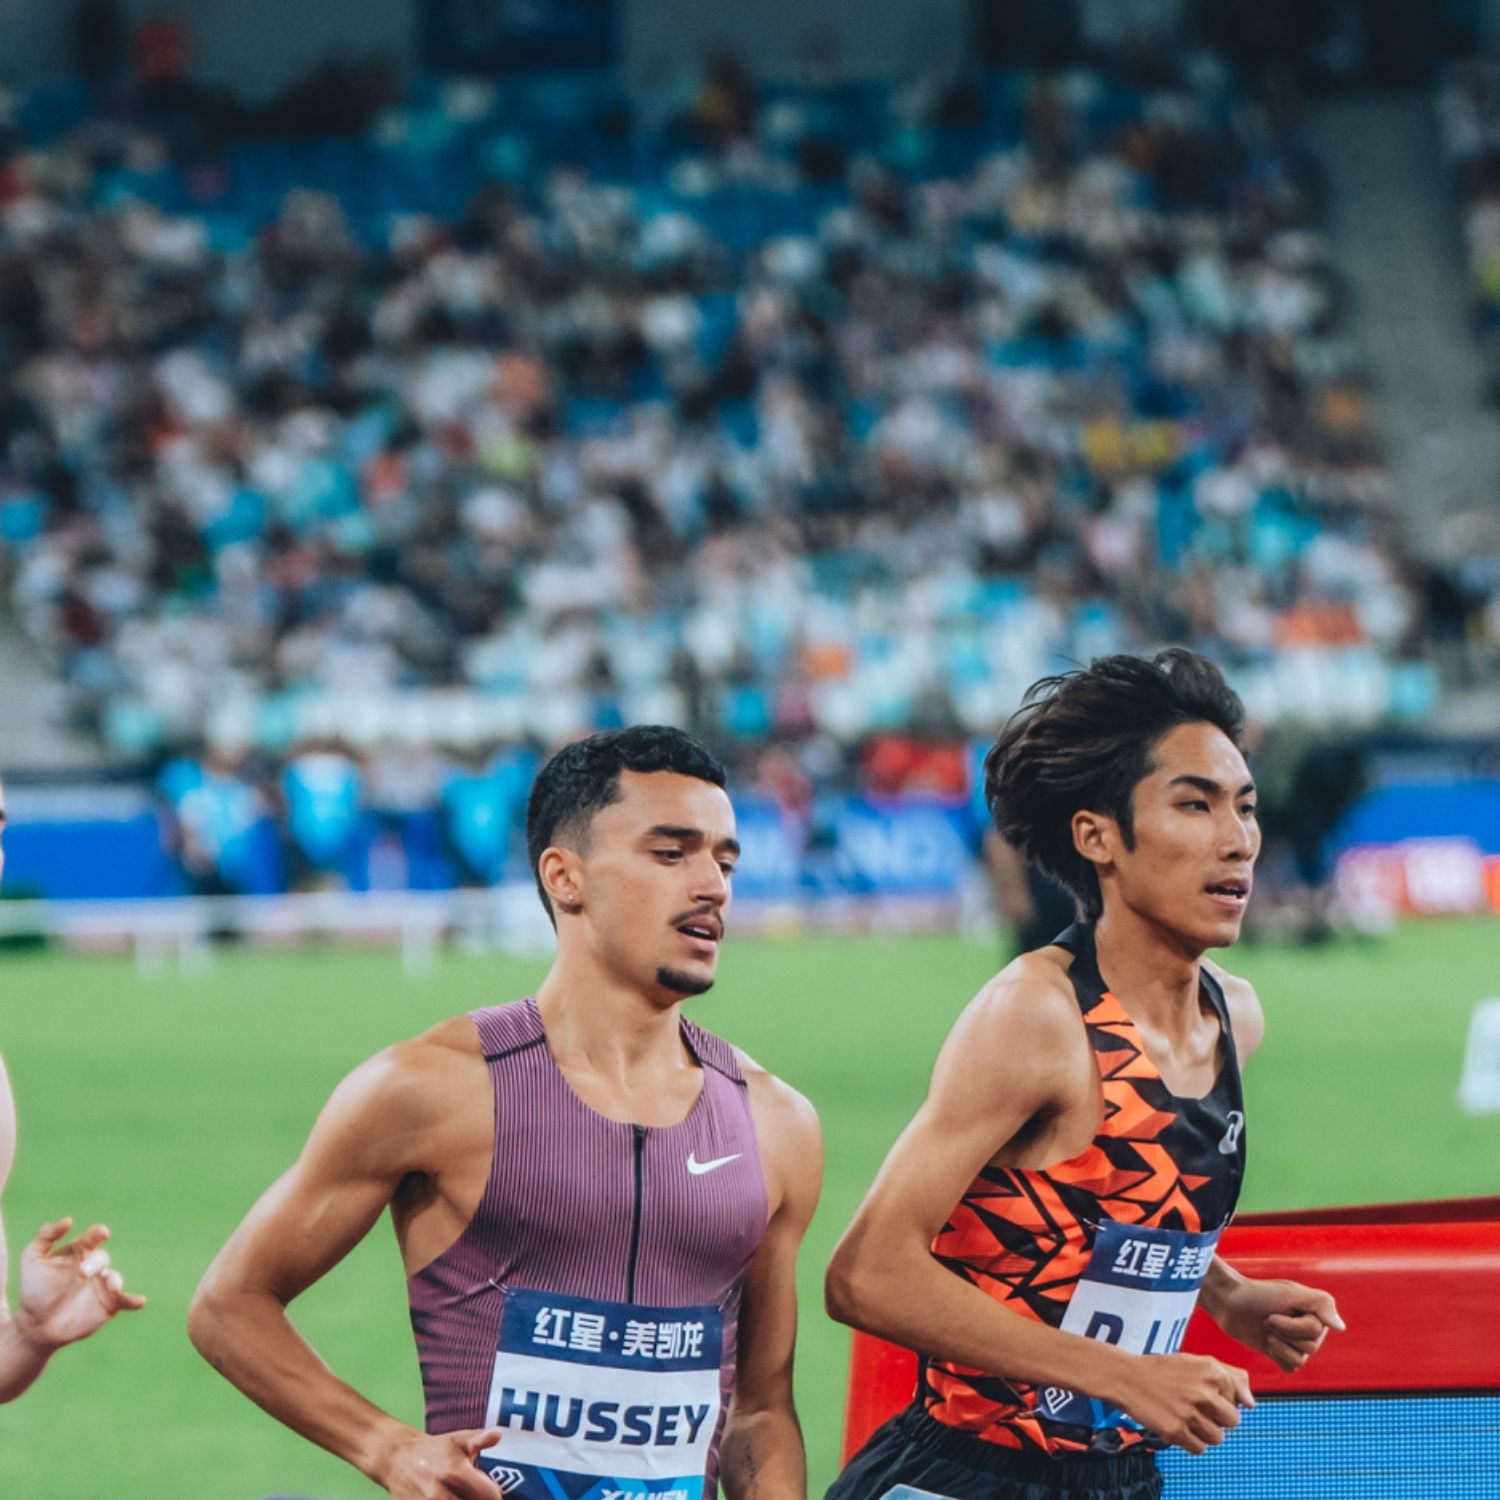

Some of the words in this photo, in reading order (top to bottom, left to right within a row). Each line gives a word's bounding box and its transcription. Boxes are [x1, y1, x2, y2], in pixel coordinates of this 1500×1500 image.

[532, 1306, 704, 1360] 红星·美凯龙
[496, 1387, 711, 1447] HUSSEY
